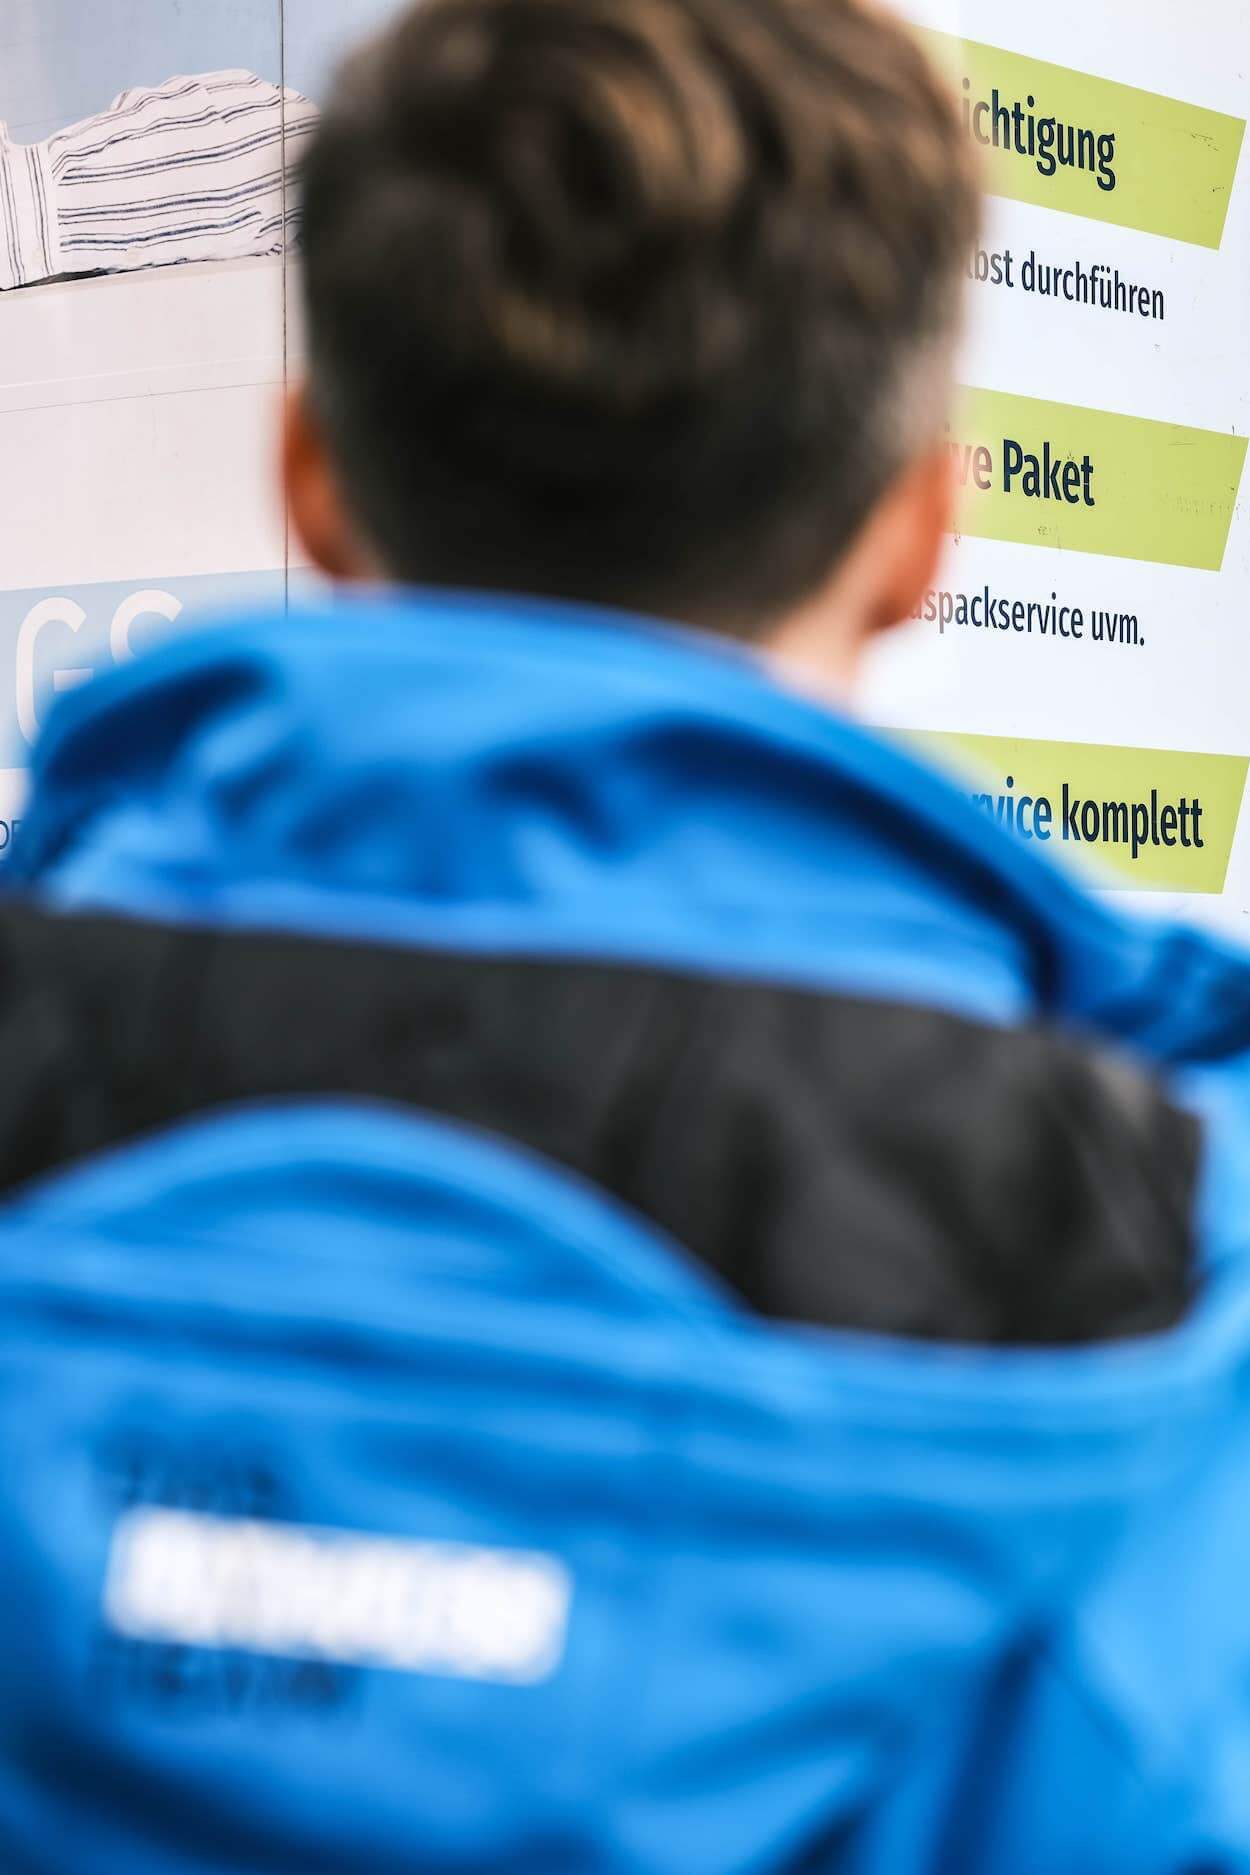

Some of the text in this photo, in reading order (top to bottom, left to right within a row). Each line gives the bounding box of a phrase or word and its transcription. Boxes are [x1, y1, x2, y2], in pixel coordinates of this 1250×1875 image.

[1021, 250, 1164, 320] durchführen
[1003, 438, 1095, 506] Paket
[1091, 610, 1145, 646] uvm.
[1062, 783, 1203, 858] komplett
